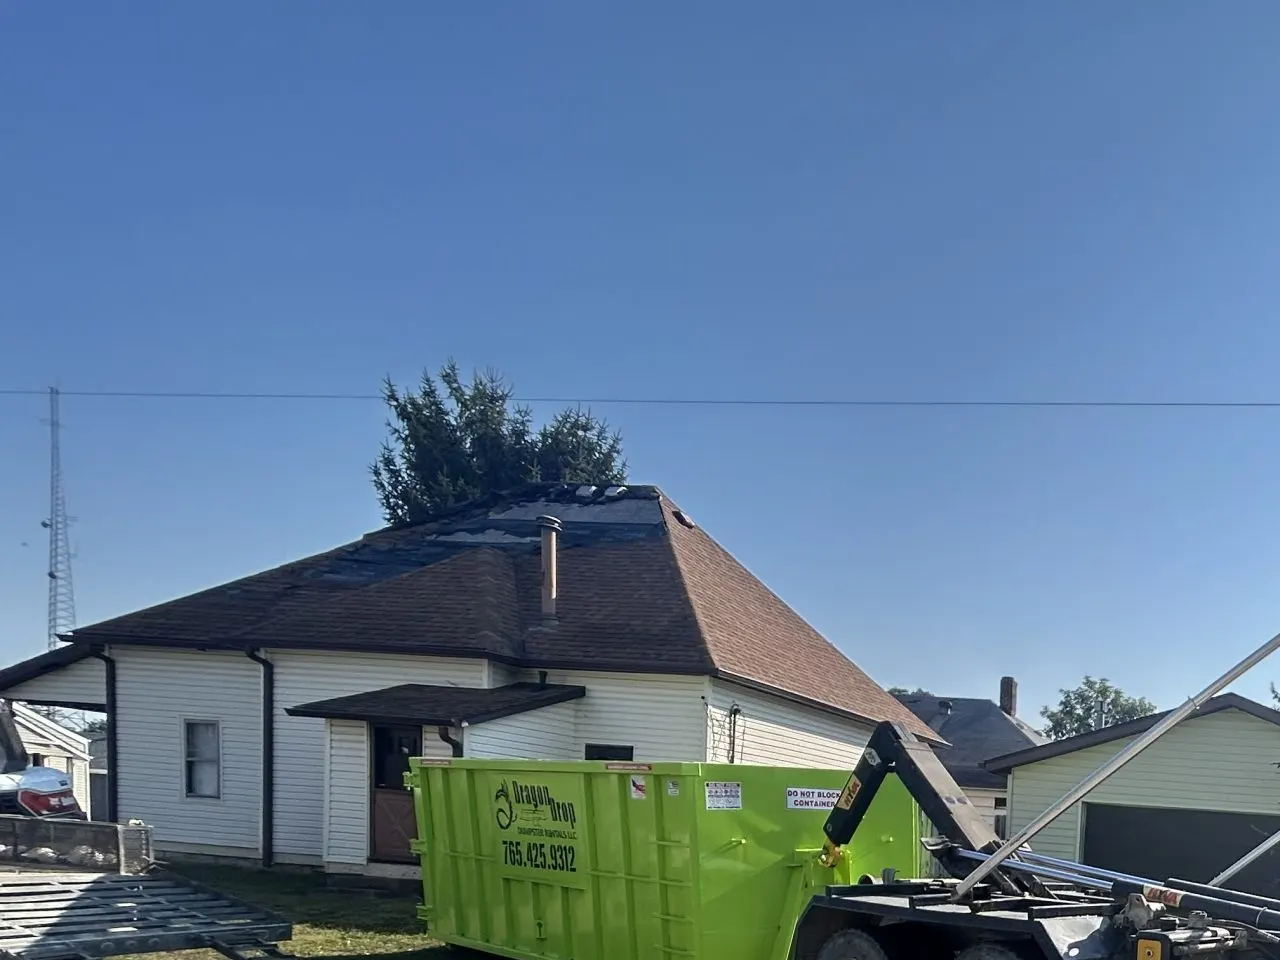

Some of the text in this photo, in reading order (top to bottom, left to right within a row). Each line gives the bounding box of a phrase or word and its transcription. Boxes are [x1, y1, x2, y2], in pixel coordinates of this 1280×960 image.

[511, 780, 577, 829] Dragon Drop
[793, 800, 836, 808] CONTAINER
[818, 791, 841, 799] BLOCK
[502, 840, 577, 872] 765.425.9312
